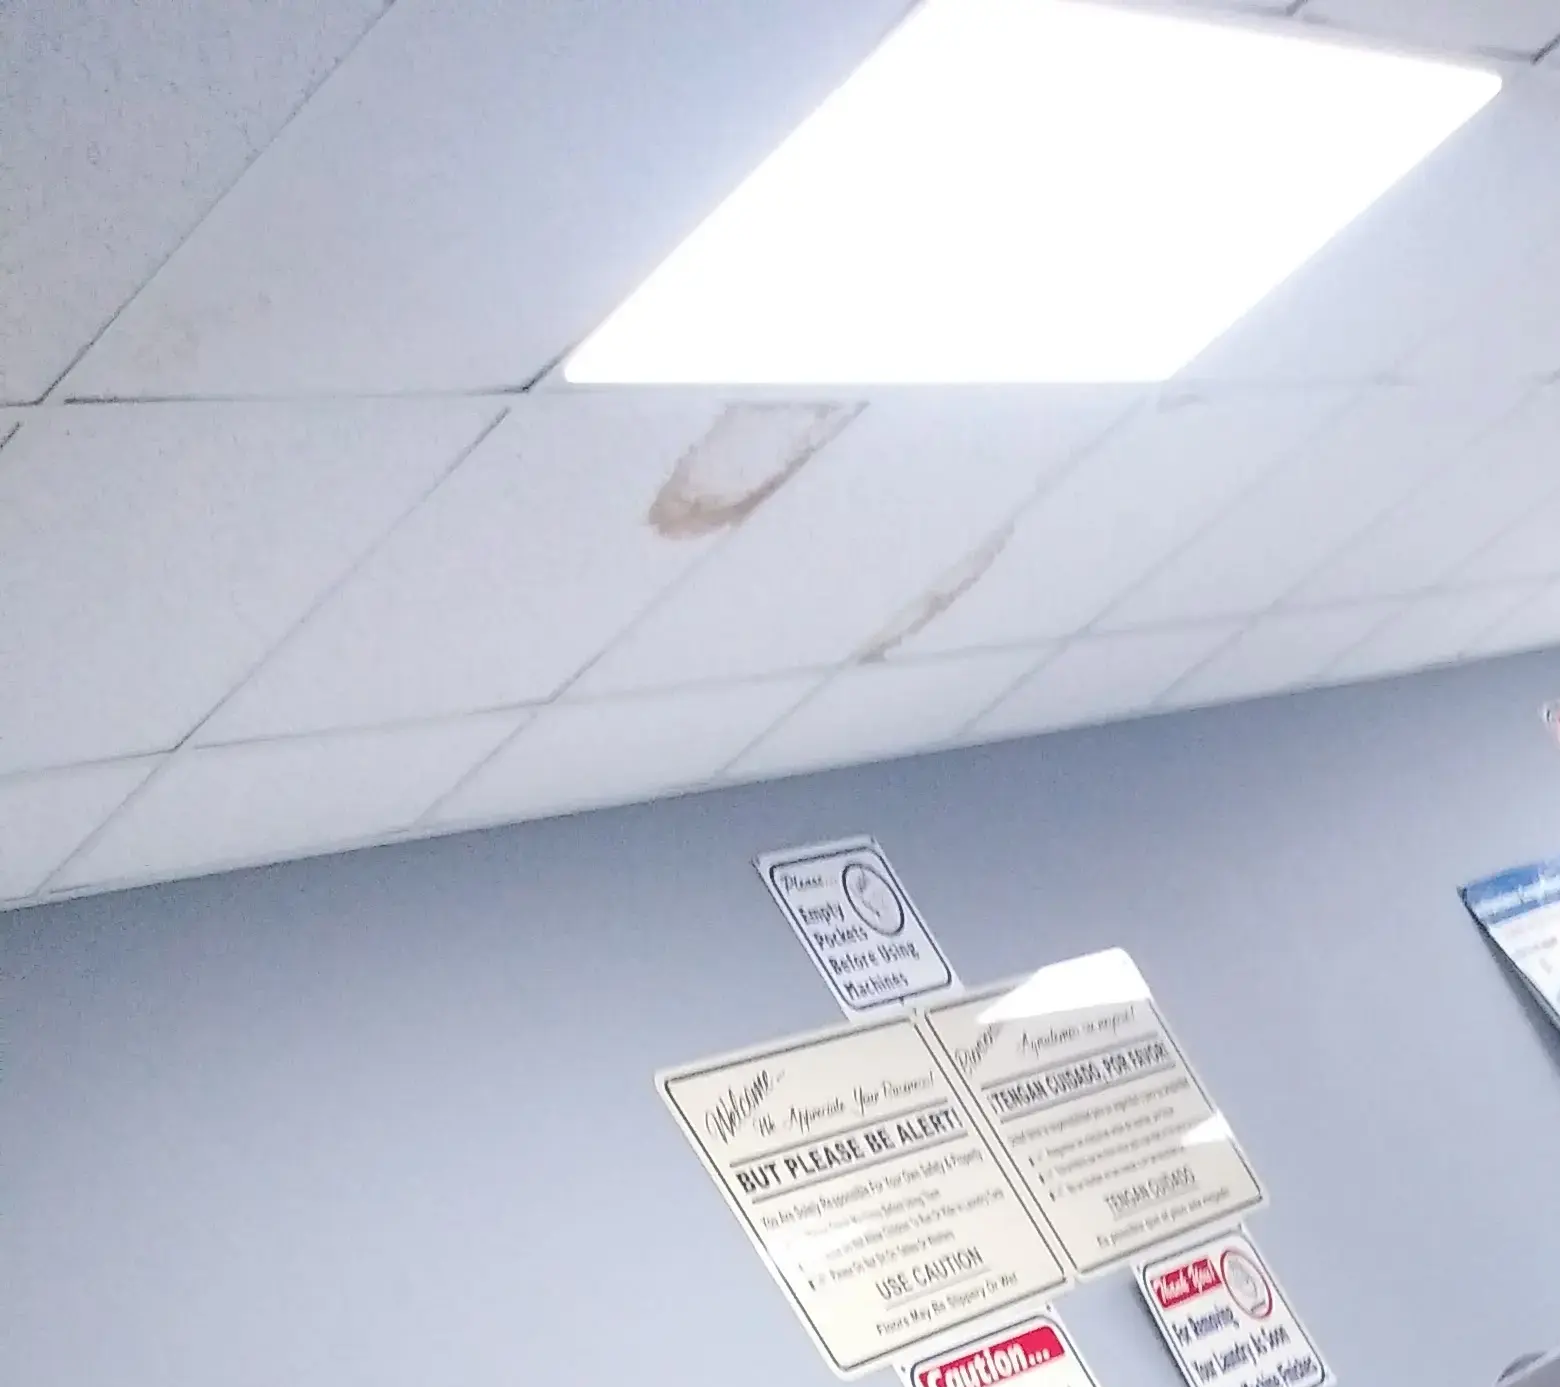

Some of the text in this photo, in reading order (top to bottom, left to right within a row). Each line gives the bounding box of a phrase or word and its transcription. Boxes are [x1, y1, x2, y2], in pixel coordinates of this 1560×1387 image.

[796, 899, 846, 924] Empty
[811, 922, 869, 951] Pockets
[826, 939, 921, 975] Before Using
[841, 966, 910, 1002] Machines
[1100, 1052, 1132, 1079] POR
[734, 1161, 786, 1194] BUT
[782, 1137, 866, 1179] PLEASE
[862, 1127, 896, 1154] BE
[892, 1106, 964, 1145] ALERT!
[1103, 1182, 1152, 1215] TENGAN
[1144, 1163, 1197, 1198] CUIDADO
[873, 1242, 985, 1301] USE CAUTION
[873, 1313, 911, 1338] Floors
[906, 1303, 934, 1326] May
[929, 1297, 947, 1314] Be
[1171, 1306, 1240, 1348] For Removing
[1192, 1319, 1292, 1384] Your Laundry As Soon
